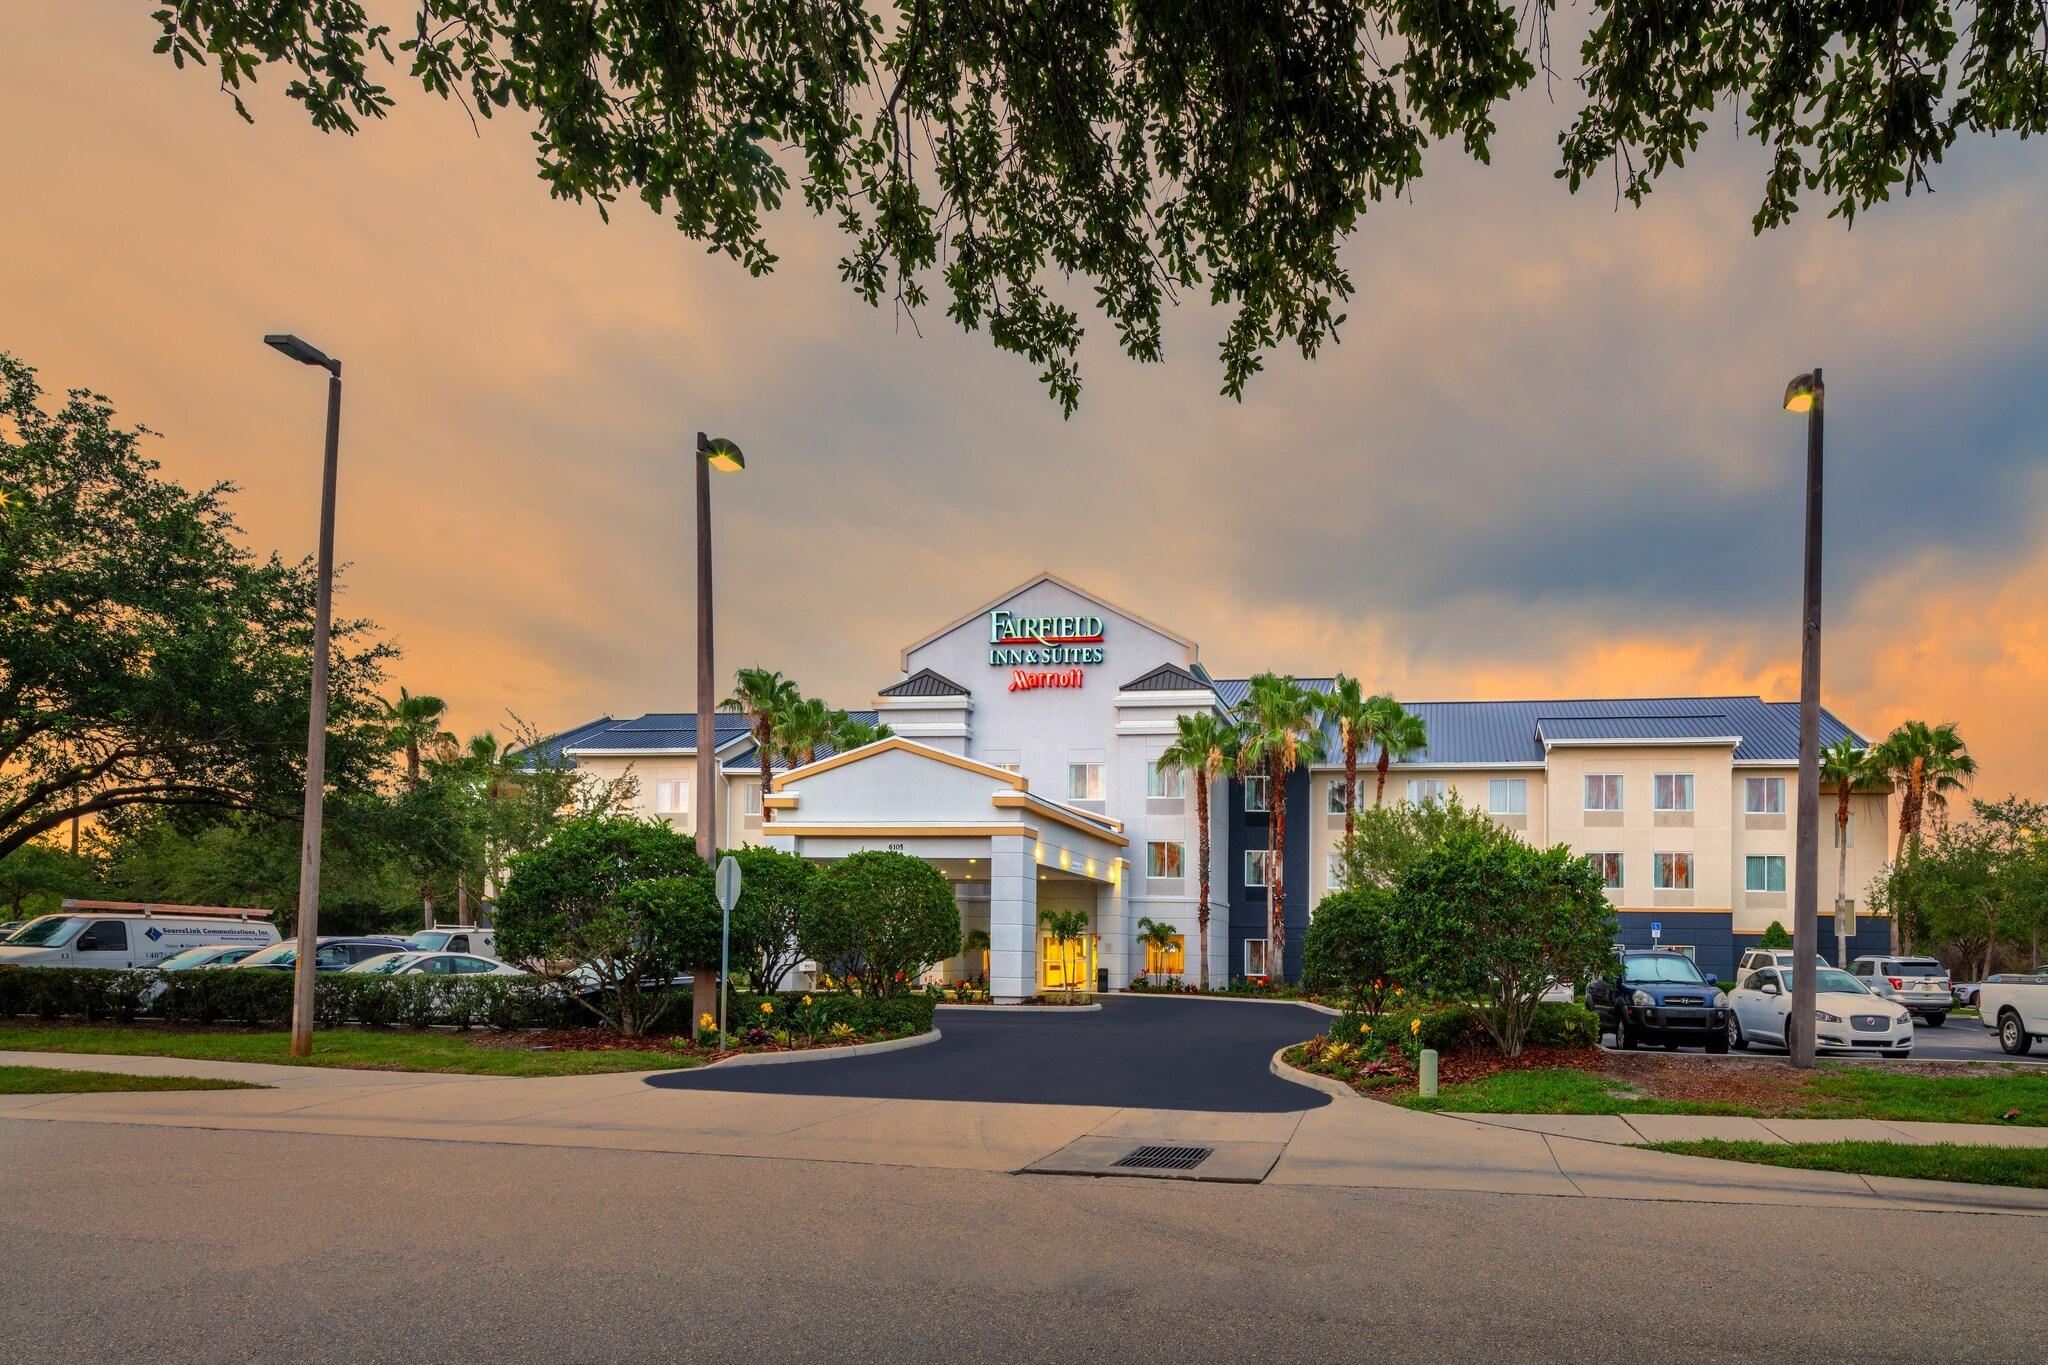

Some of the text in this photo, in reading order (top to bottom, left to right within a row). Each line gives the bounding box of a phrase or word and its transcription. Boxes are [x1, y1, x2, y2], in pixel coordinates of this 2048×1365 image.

[989, 611, 1104, 646] FAIRFIELD
[990, 648, 1103, 665] INN & SUITES
[1008, 669, 1083, 692] Marriott
